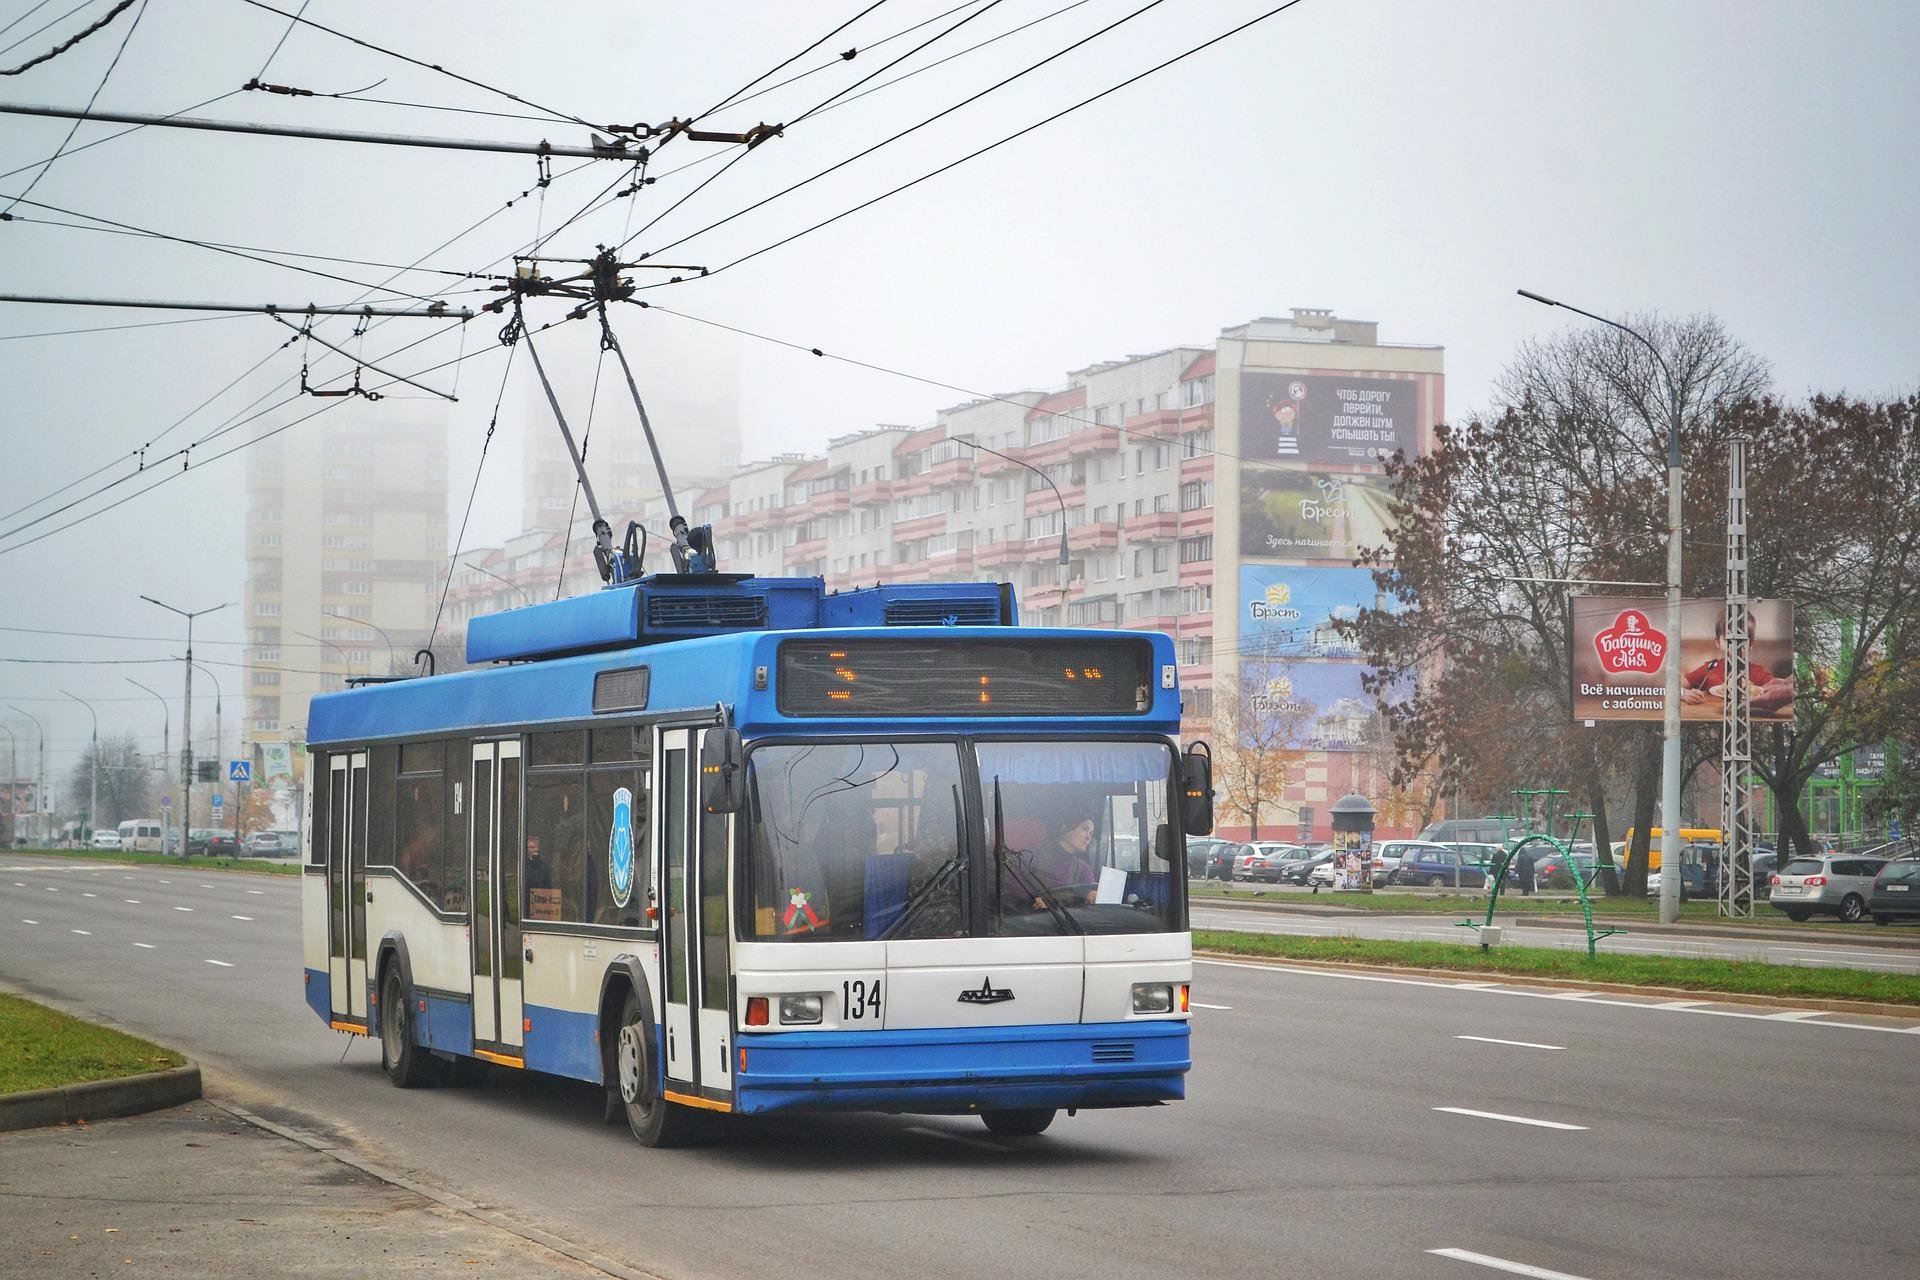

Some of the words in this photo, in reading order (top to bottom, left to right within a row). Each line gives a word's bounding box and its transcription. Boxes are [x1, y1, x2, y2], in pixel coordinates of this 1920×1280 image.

[1299, 499, 1356, 523] Брест
[1266, 534, 1292, 549] Здесь
[1250, 601, 1300, 621] Брэст
[1600, 632, 1662, 657] Бабушка
[1612, 650, 1647, 668] Аня
[1580, 683, 1603, 696] Всё
[1602, 699, 1610, 709] с
[1612, 697, 1663, 710] заботы
[843, 979, 882, 1020] 134
